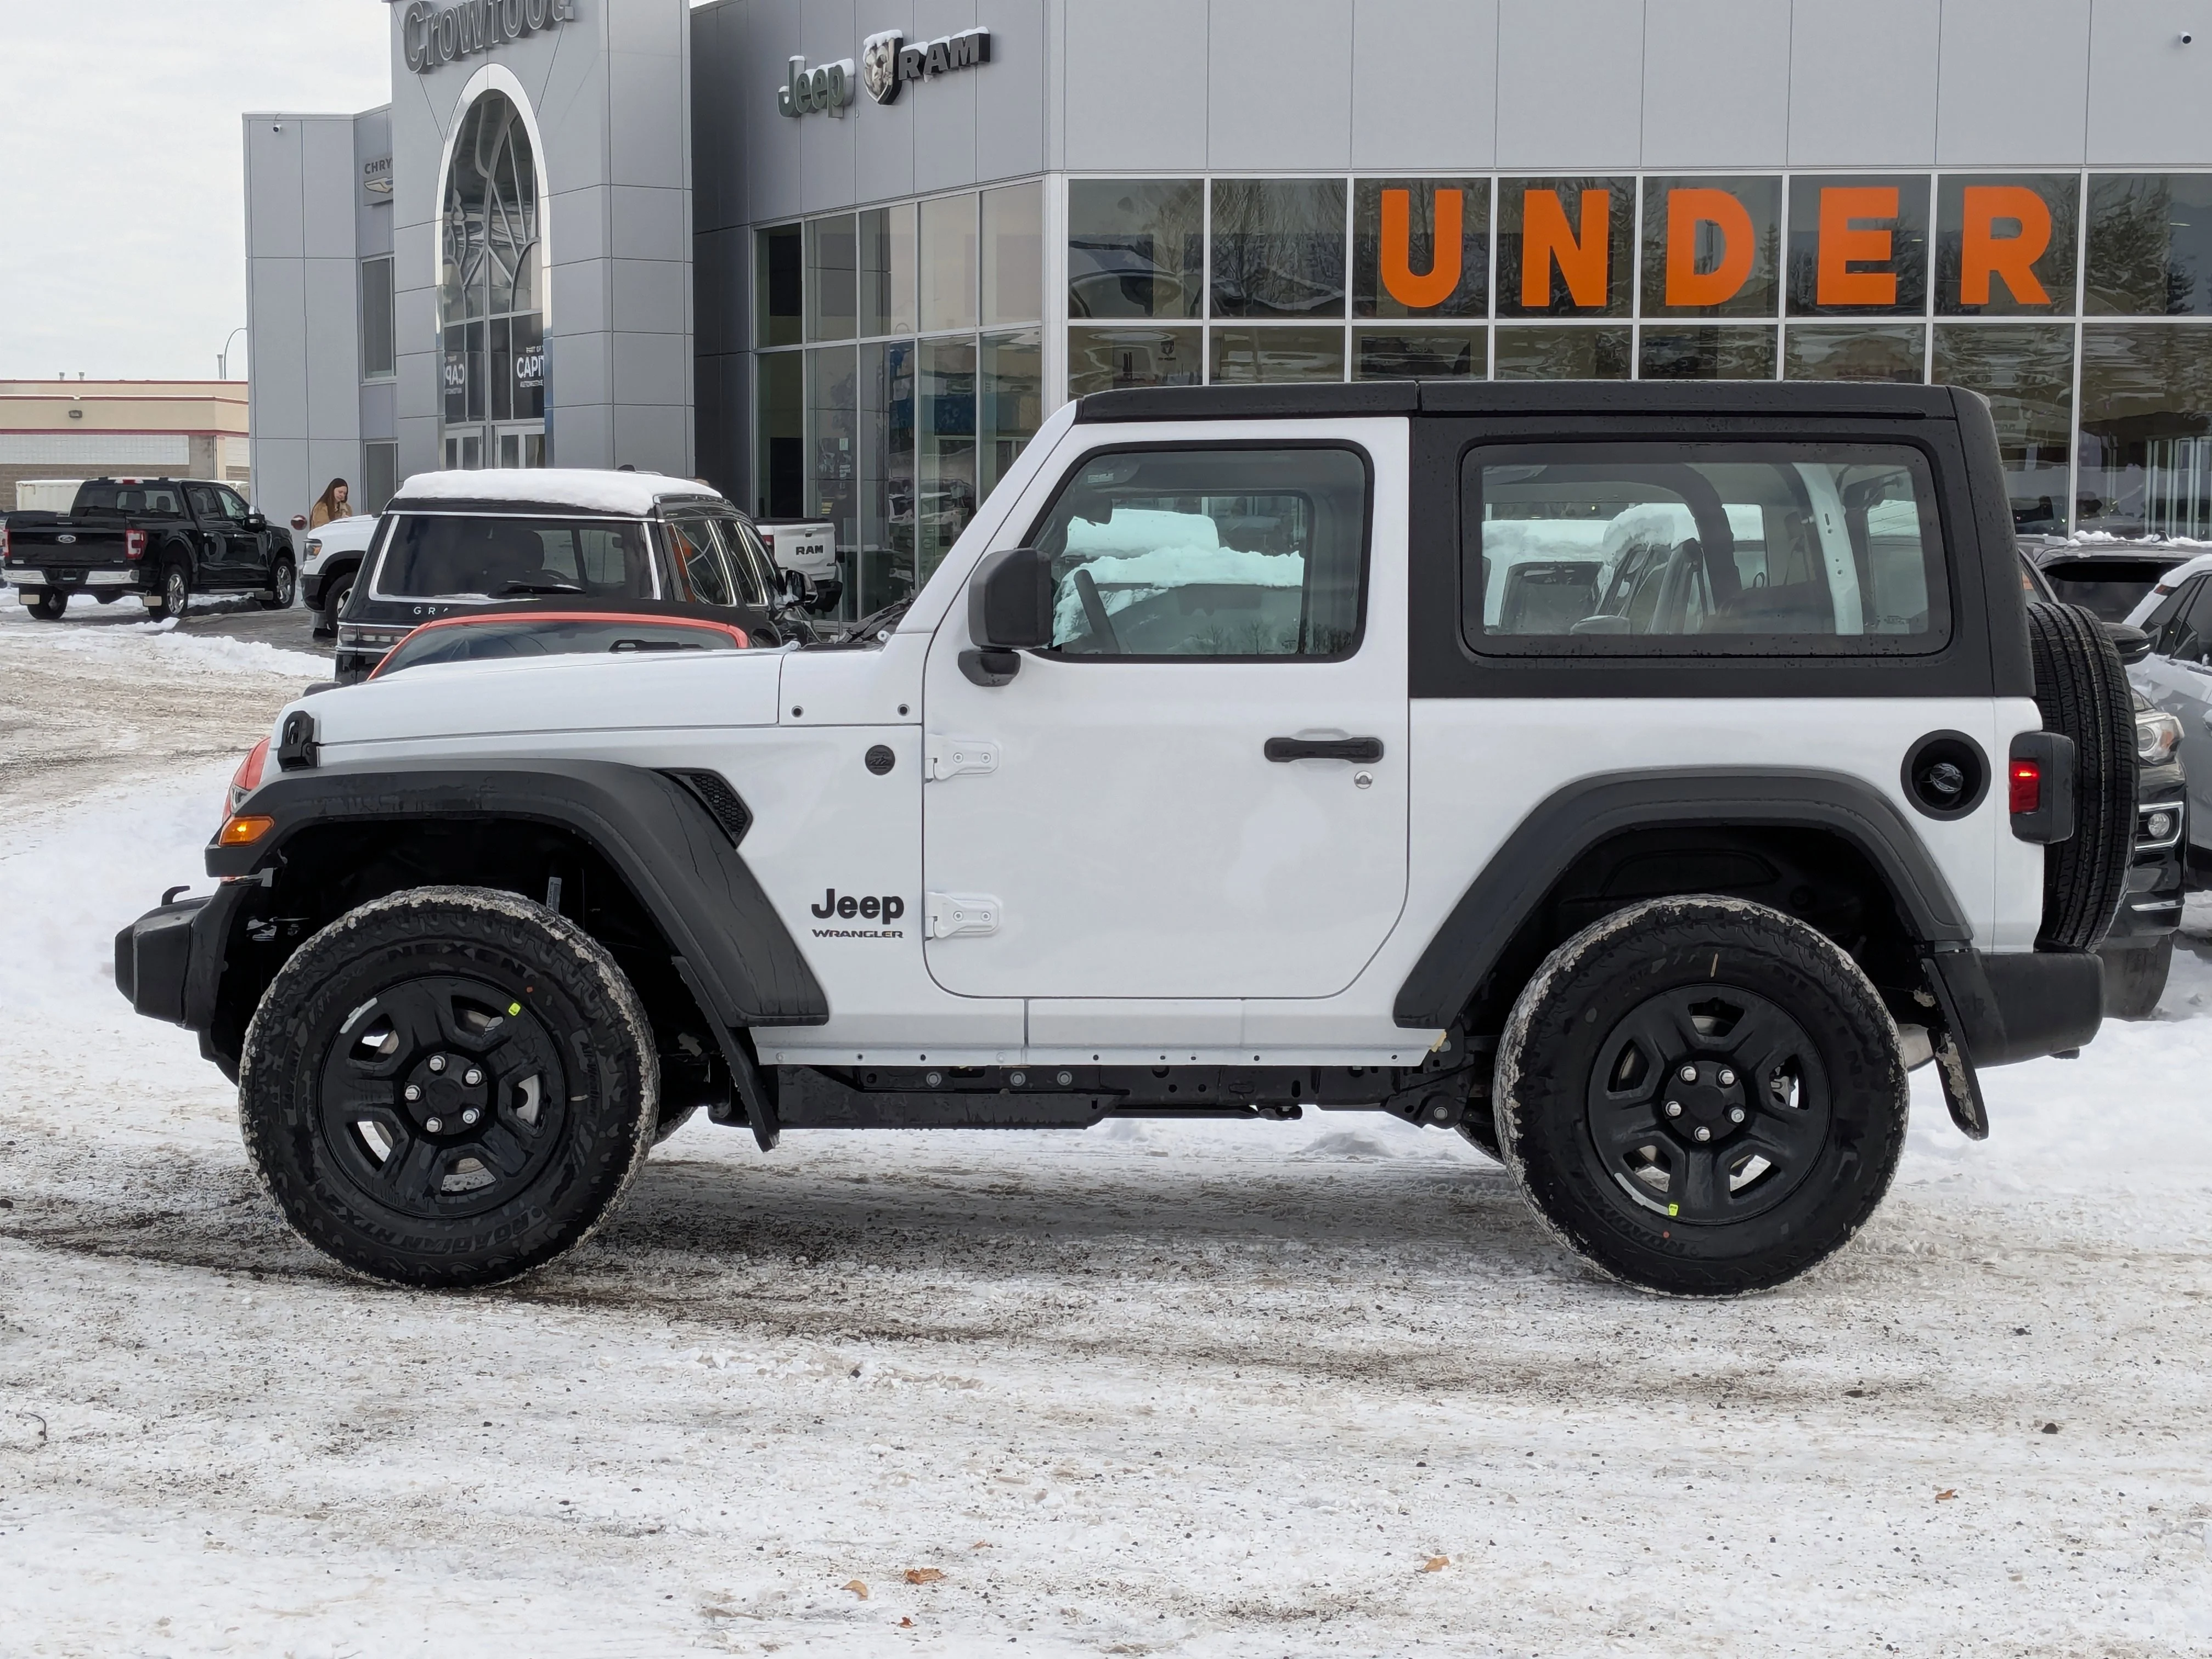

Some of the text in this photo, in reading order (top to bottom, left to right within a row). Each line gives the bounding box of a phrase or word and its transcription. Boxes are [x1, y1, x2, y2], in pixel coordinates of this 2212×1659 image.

[898, 30, 991, 81] RAM
[777, 55, 855, 119] Jeep
[1380, 186, 2052, 307] UNDER
[795, 545, 823, 555] RAM
[811, 888, 904, 924] Jeep
[812, 929, 904, 938] WRANGLER
